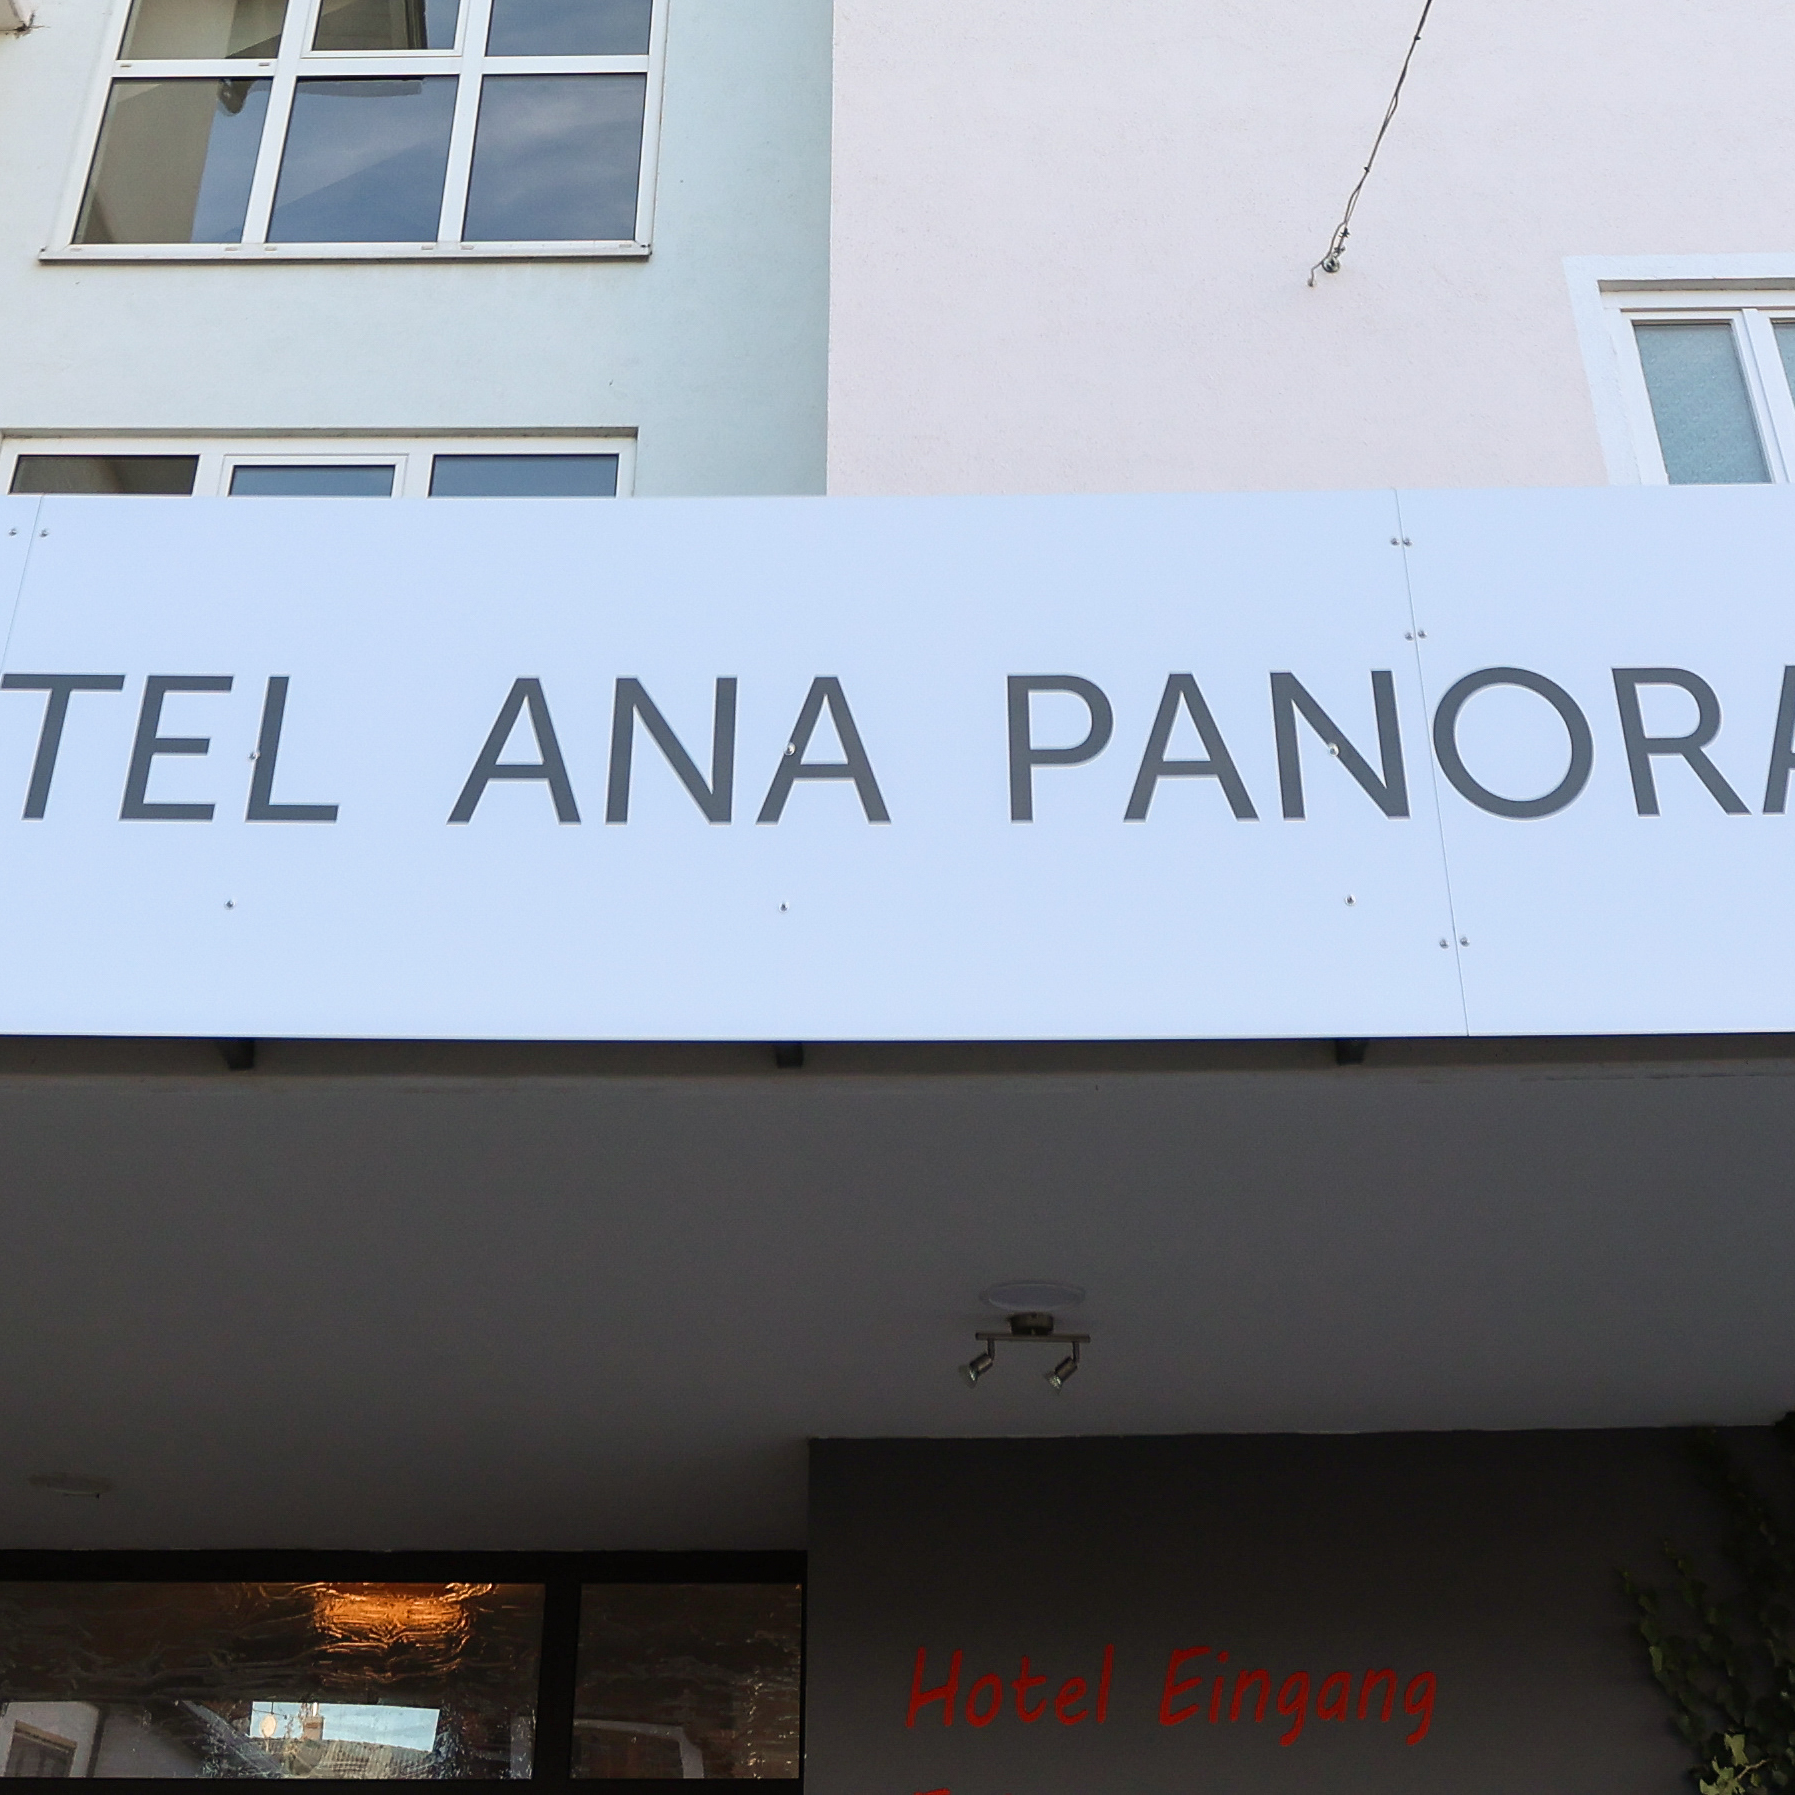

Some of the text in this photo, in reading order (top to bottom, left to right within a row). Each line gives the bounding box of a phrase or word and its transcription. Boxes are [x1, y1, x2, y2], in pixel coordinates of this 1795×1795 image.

[447, 676, 891, 824] ANA
[905, 1643, 1437, 1748] Hotel Eingang
